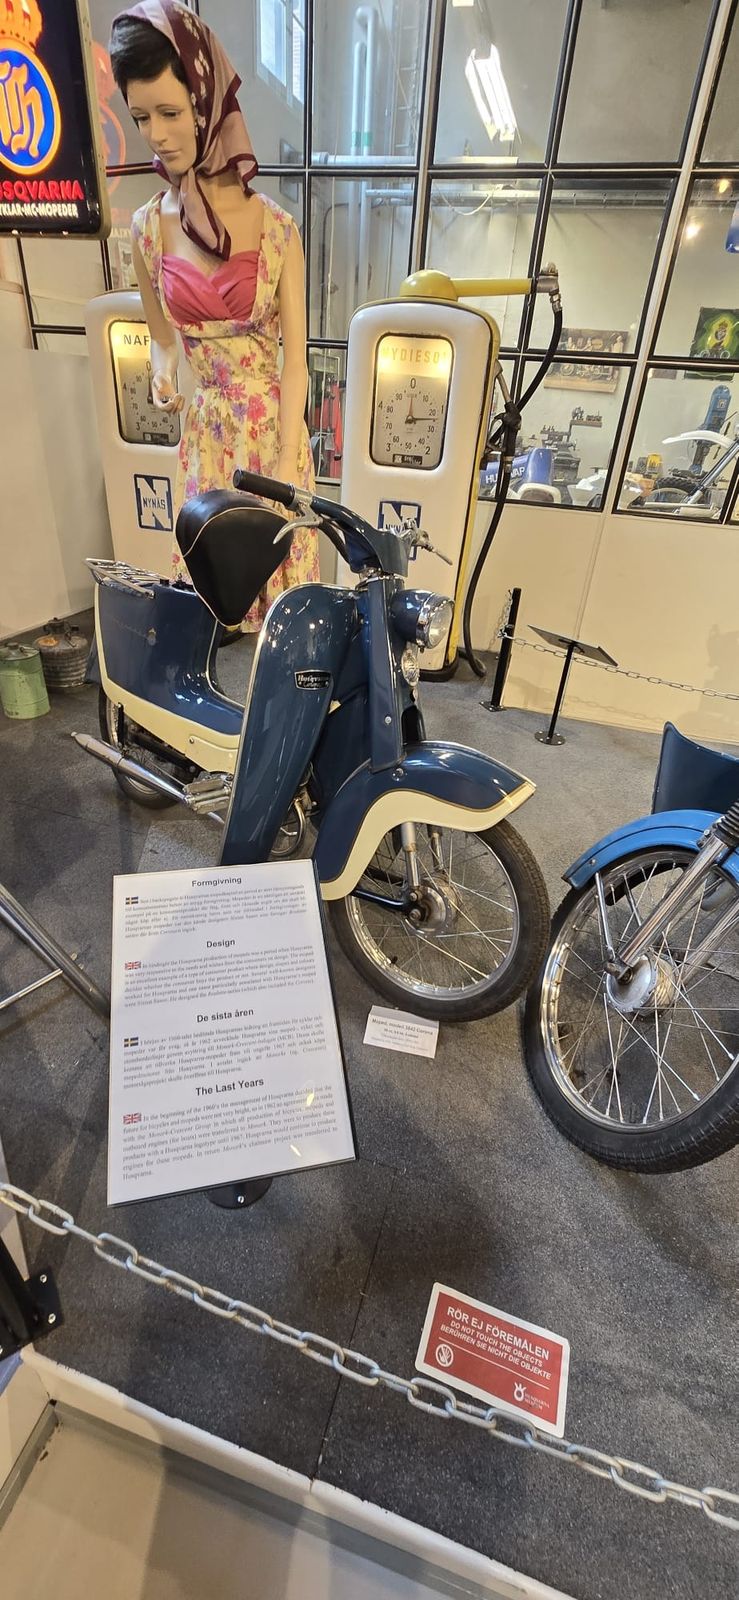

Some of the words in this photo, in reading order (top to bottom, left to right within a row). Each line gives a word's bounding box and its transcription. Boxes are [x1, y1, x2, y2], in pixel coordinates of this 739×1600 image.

[0, 180, 84, 202] SQVARNA
[123, 333, 151, 346] NAF
[191, 876, 242, 888] Formgivning
[206, 938, 236, 950] Design
[196, 1013, 209, 1023] De
[211, 1011, 232, 1021] sista
[234, 1008, 254, 1018] åren
[195, 1086, 213, 1097] The
[215, 1083, 236, 1093] Last
[238, 1078, 264, 1089] Years
[447, 1305, 469, 1322] RÖR
[471, 1316, 483, 1329] EJ
[485, 1322, 550, 1361] FÖREMÅLEN
[440, 1324, 475, 1345] BERÜHREN
[476, 1339, 487, 1350] SIE
[487, 1346, 508, 1361] NICHT
[508, 1354, 520, 1365] DIE
[520, 1359, 552, 1380] OBJEKTE
[450, 1320, 460, 1329] DO
[461, 1325, 475, 1336] NOT
[476, 1330, 498, 1346] TOUCH
[499, 1340, 512, 1353] THE
[512, 1346, 543, 1367] OBJECTS
